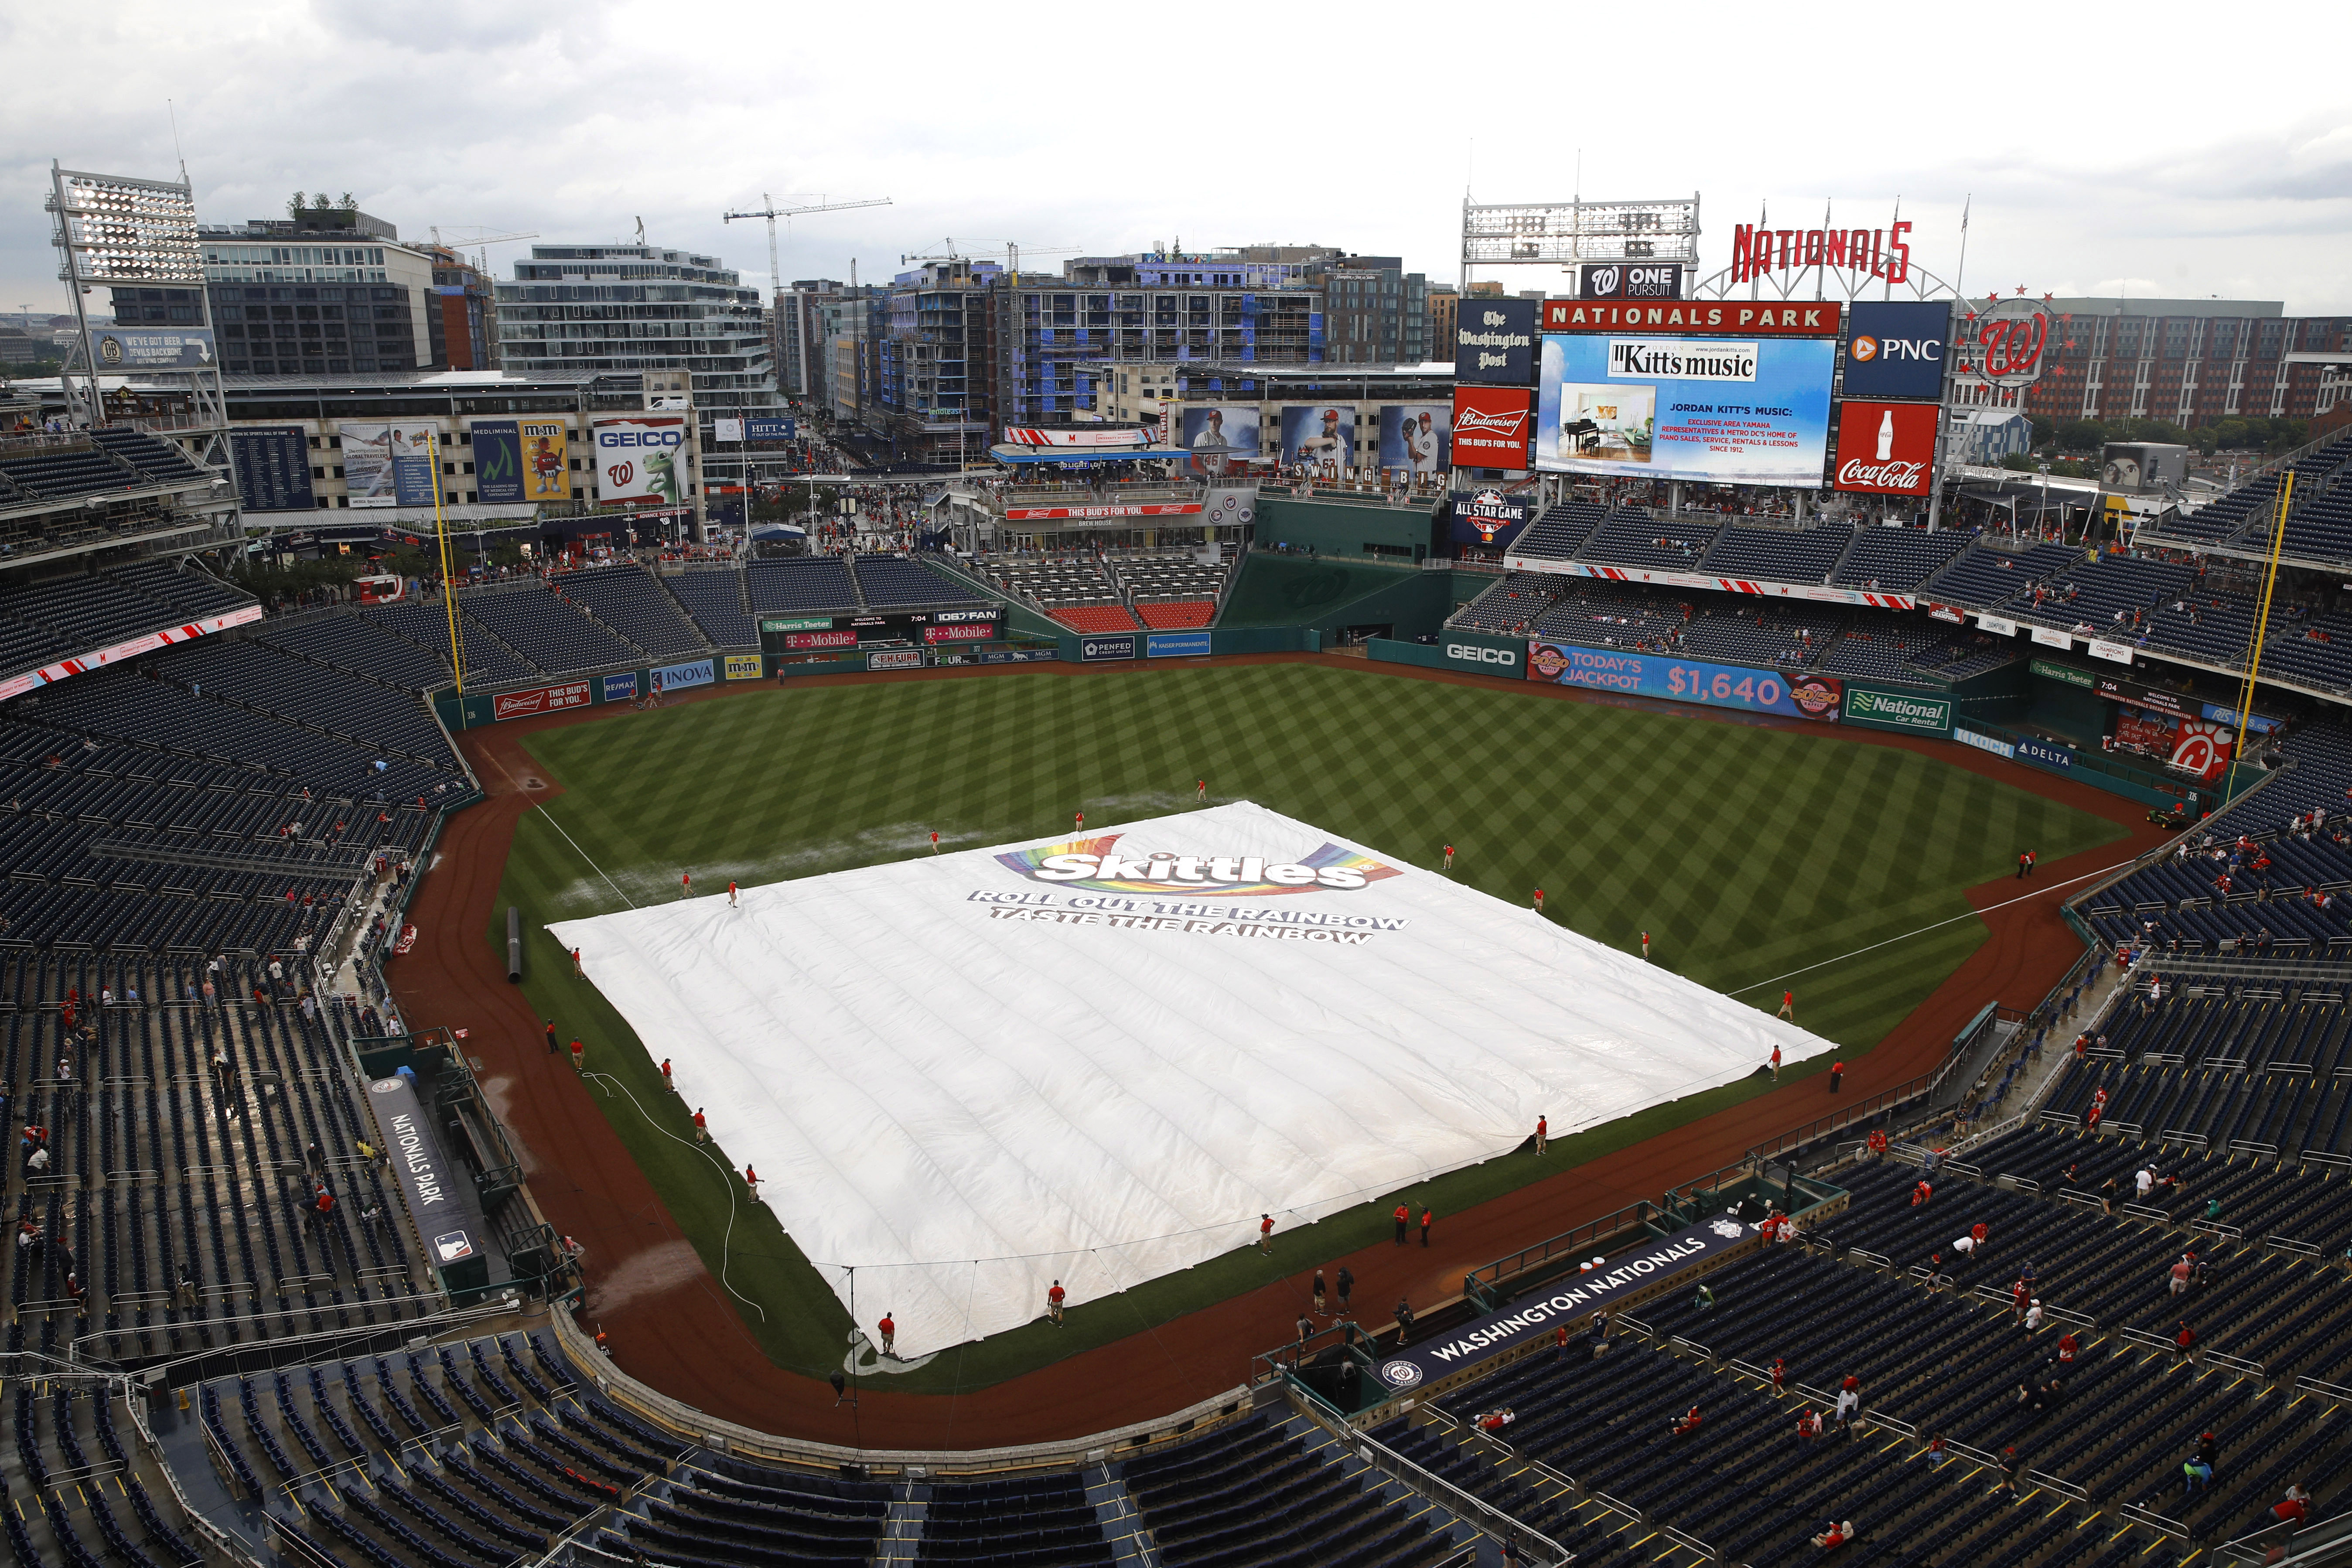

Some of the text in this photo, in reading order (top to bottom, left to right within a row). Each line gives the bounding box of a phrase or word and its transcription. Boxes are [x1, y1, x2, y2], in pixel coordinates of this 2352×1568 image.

[1731, 221, 1912, 284] NATIONALS
[1629, 268, 1672, 284] ONE
[1628, 284, 1671, 296] PURSUIT
[1483, 311, 1506, 328] The
[1552, 307, 1821, 327] NATIONALS PARK
[126, 337, 183, 346] WE'VE GOT BEER.
[1458, 328, 1530, 349] Washington
[105, 343, 117, 358] DB
[129, 348, 183, 357] DEVILS BACKBONE
[1881, 338, 1940, 361] PNC
[1478, 352, 1507, 370] Post
[1624, 345, 1753, 377] Kitt's music
[1670, 403, 1792, 416] JORDAN KITT'S MUSIC:
[1662, 426, 1719, 434] REPRESENTATIVES
[600, 431, 681, 447] GEICO
[1473, 439, 1492, 447] BUD'S
[1507, 441, 1521, 449] YOU.
[1206, 454, 1218, 466] 46
[1839, 458, 1926, 489] Coca-Cola
[1087, 508, 1109, 516] BUD'S
[1110, 507, 1124, 515] FOR
[1126, 506, 1144, 515] YOU.
[1455, 503, 1522, 519] ALL STAR GAME
[969, 611, 996, 619] FAN
[1931, 611, 1959, 622] CHAMPIONS
[1987, 621, 2006, 632] CHAMPIONS
[2040, 634, 2061, 644] CHAMPIONS
[1447, 643, 1516, 666] GEICO
[2096, 645, 2124, 656] CHAMPIONS
[1530, 655, 1570, 668] 50/50
[1572, 652, 1642, 673] TODAY'S
[667, 666, 712, 684] INOVA
[1566, 669, 1642, 690] JACKPOT
[2041, 666, 2092, 685] Harris Teeter
[548, 684, 588, 698] THIS BUD'S
[606, 681, 635, 691] RE/MAX
[1667, 665, 1780, 705] $1,640
[2101, 681, 2117, 691] 7:04
[550, 696, 582, 707] FOR YOU.
[1790, 687, 1840, 704] 50/50
[2143, 697, 2167, 706] NATIONALS
[2148, 692, 2170, 700] WELCOME
[1872, 697, 1943, 719] National
[2100, 691, 2125, 702] WASHINGTON
[2126, 699, 2148, 708] NATIONALS
[2165, 709, 2191, 720] FOUNDATION
[467, 711, 476, 720] 336
[1911, 717, 1938, 726] Rental
[2031, 746, 2069, 766] DELTA
[2188, 791, 2197, 802] 335
[1034, 851, 1369, 890] Skittles
[973, 890, 1412, 931] ROLL OUT THE RAINBOW
[990, 906, 1375, 946] TASTE THE RAINBOW
[390, 1114, 444, 1206] NATIONALS PARK
[1430, 1237, 1706, 1362] WASHINGTON NATIONALS
